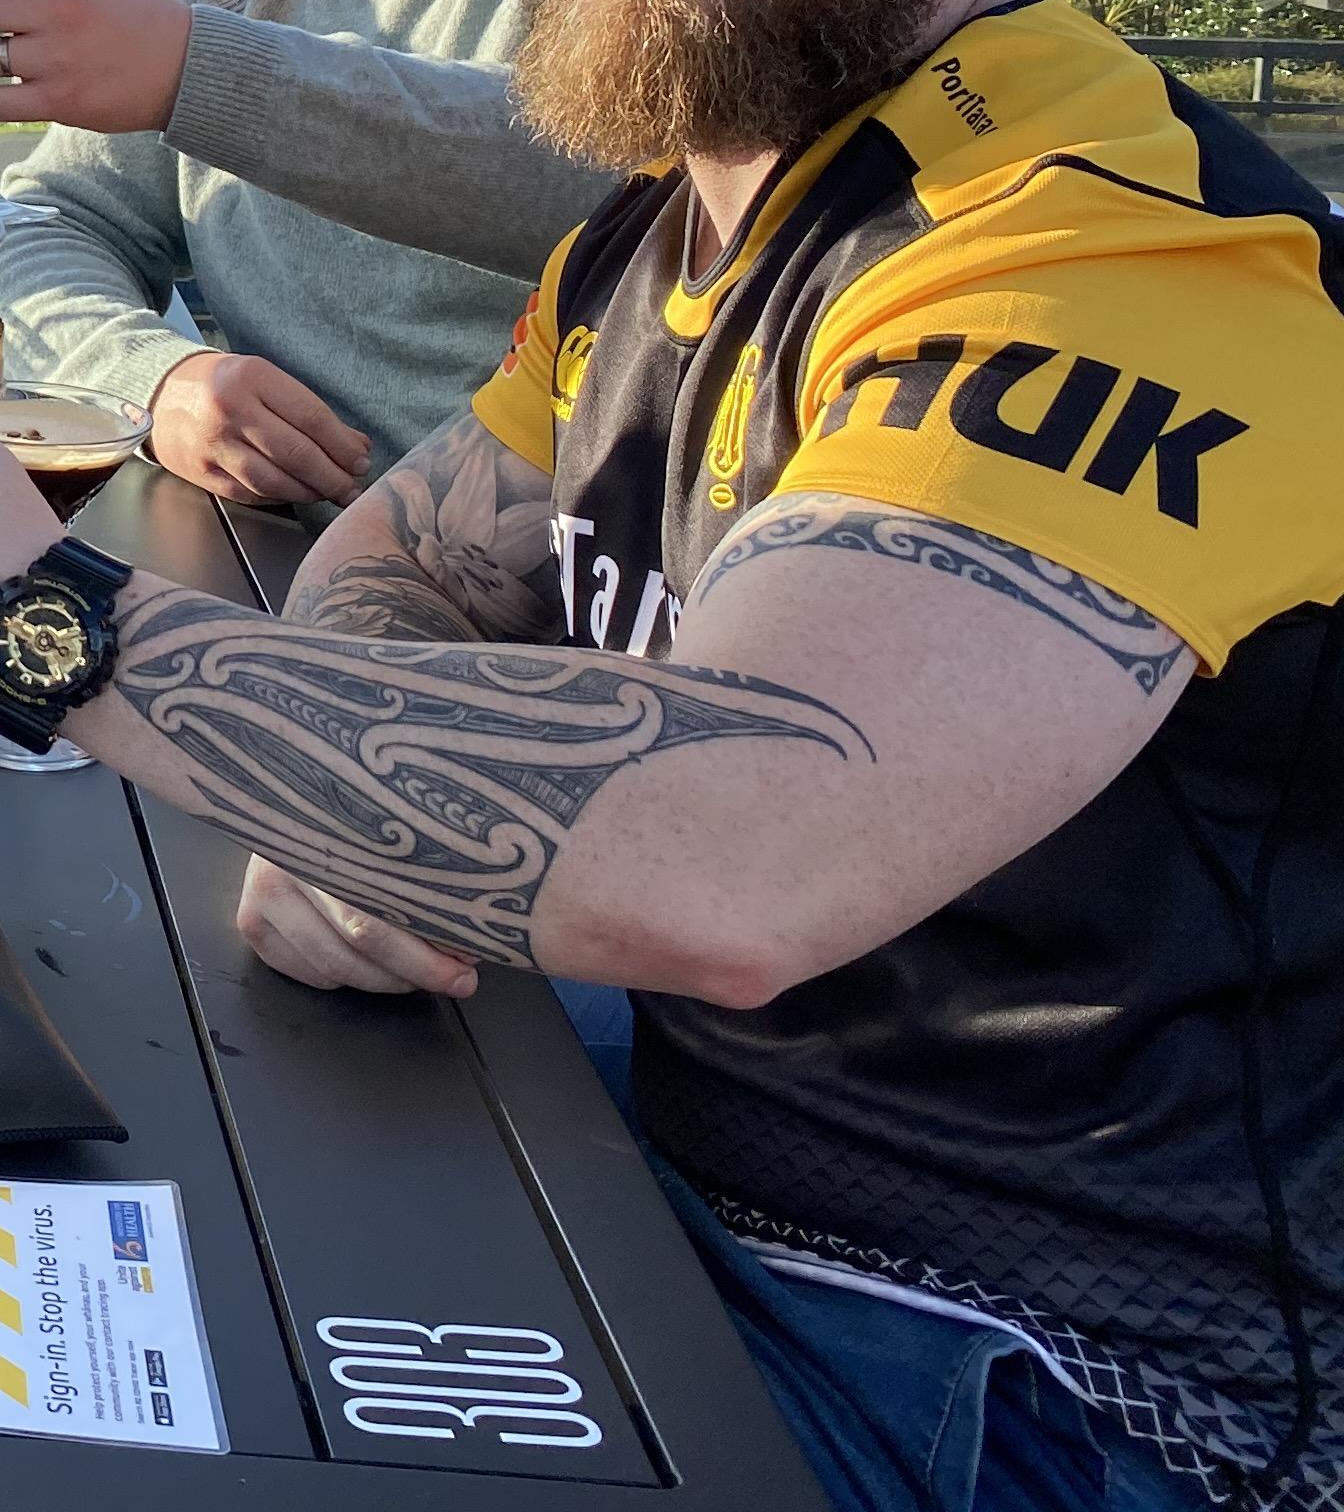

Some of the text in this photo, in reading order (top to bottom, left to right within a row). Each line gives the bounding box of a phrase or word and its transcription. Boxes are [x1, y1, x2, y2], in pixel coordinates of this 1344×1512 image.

[930, 57, 999, 138] PortTara
[119, 1203, 140, 1239] HEALTH
[28, 1204, 78, 1415] Sign-in. Stop the virus.
[89, 1373, 104, 1402] protect
[93, 1402, 105, 1421] Help
[316, 1317, 602, 1448] 303
